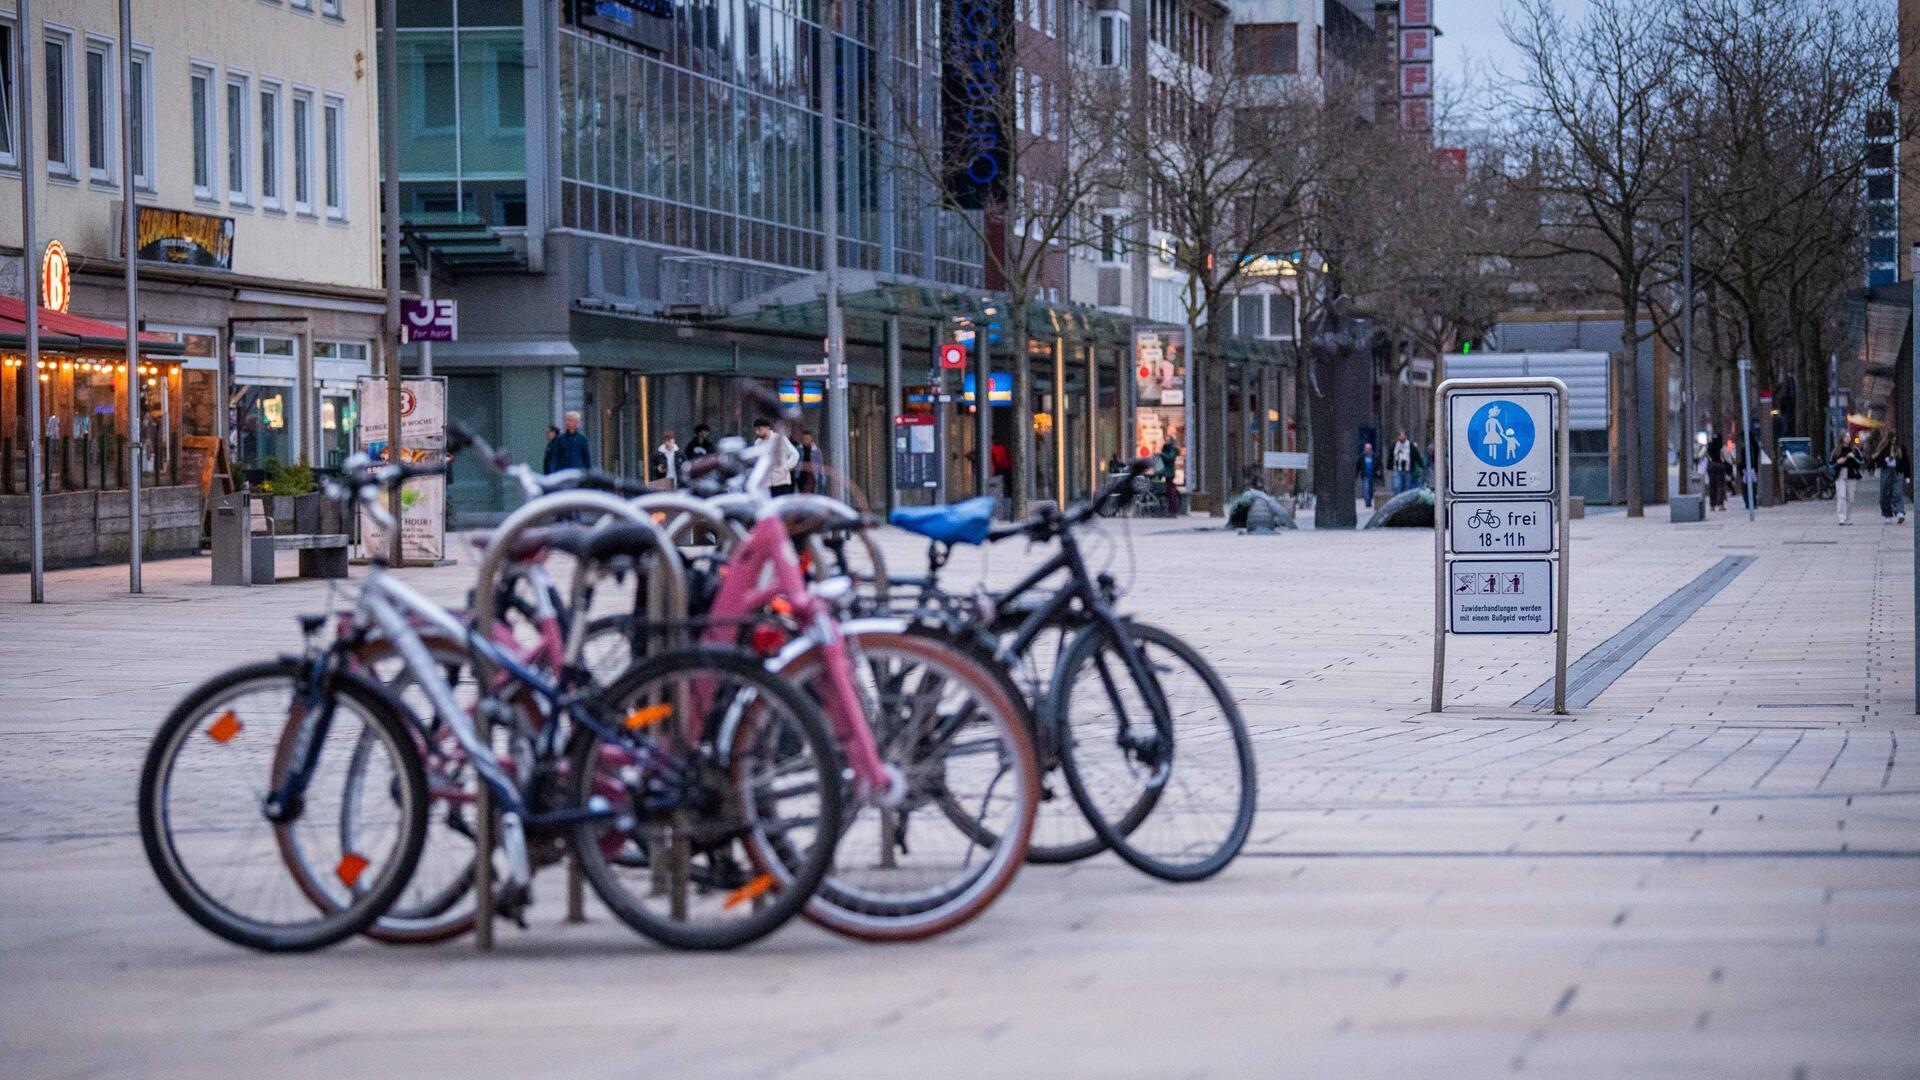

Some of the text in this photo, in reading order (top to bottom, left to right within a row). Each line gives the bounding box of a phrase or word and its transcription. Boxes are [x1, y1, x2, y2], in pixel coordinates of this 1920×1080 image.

[50, 253, 64, 310] B
[413, 330, 427, 339] for
[1477, 471, 1527, 487] ZONE
[1508, 511, 1536, 526] frei
[1479, 532, 1492, 547] 18
[1461, 604, 1542, 613] Zuwiderhandlungen werden
[1491, 614, 1516, 623] Bußgeld
[1518, 614, 1543, 623] verfolgt.
